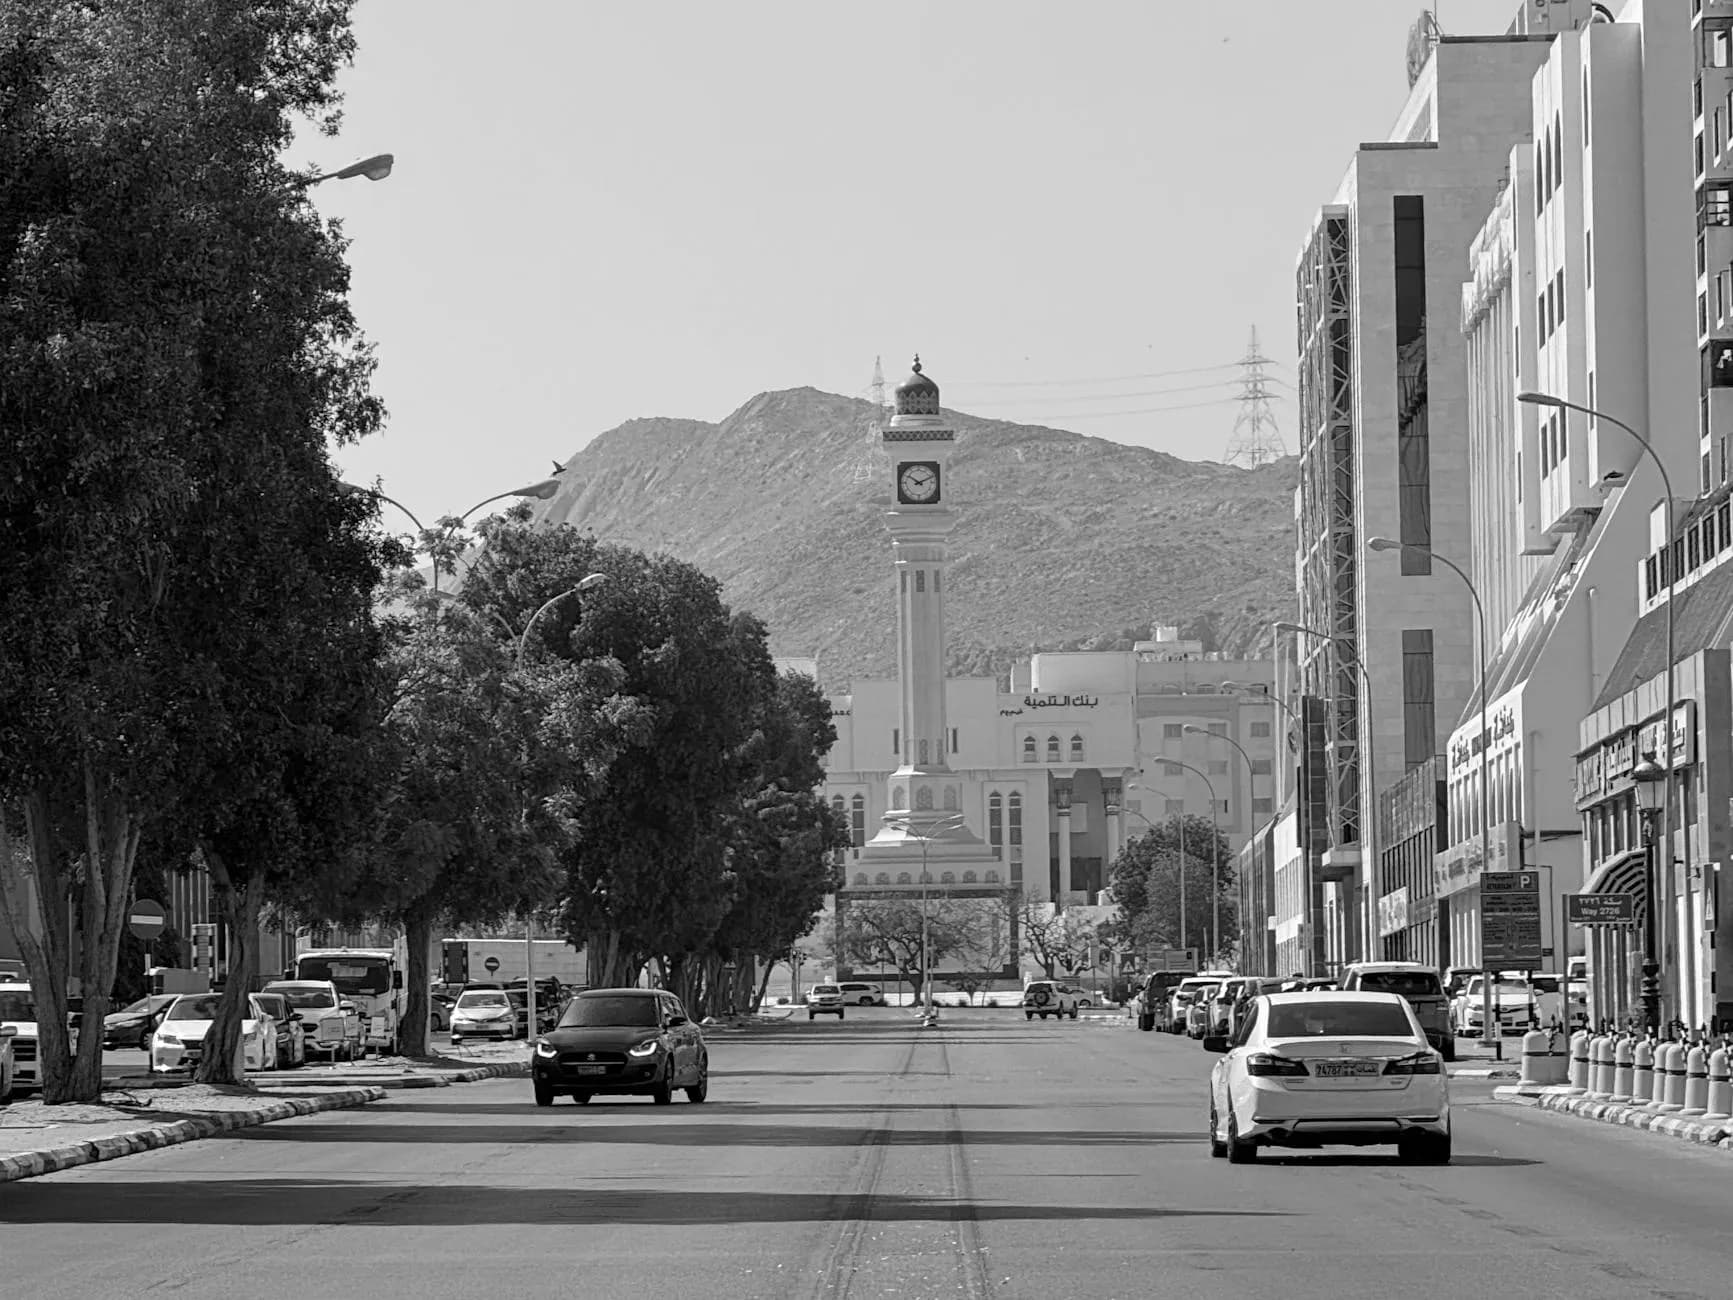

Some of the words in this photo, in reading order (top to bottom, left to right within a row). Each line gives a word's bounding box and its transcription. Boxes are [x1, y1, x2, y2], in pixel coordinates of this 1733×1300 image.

[1024, 695, 1070, 709] التنمية
[1072, 694, 1098, 708] بنك
[1520, 875, 1530, 888] P
[1581, 907, 1598, 916] Way
